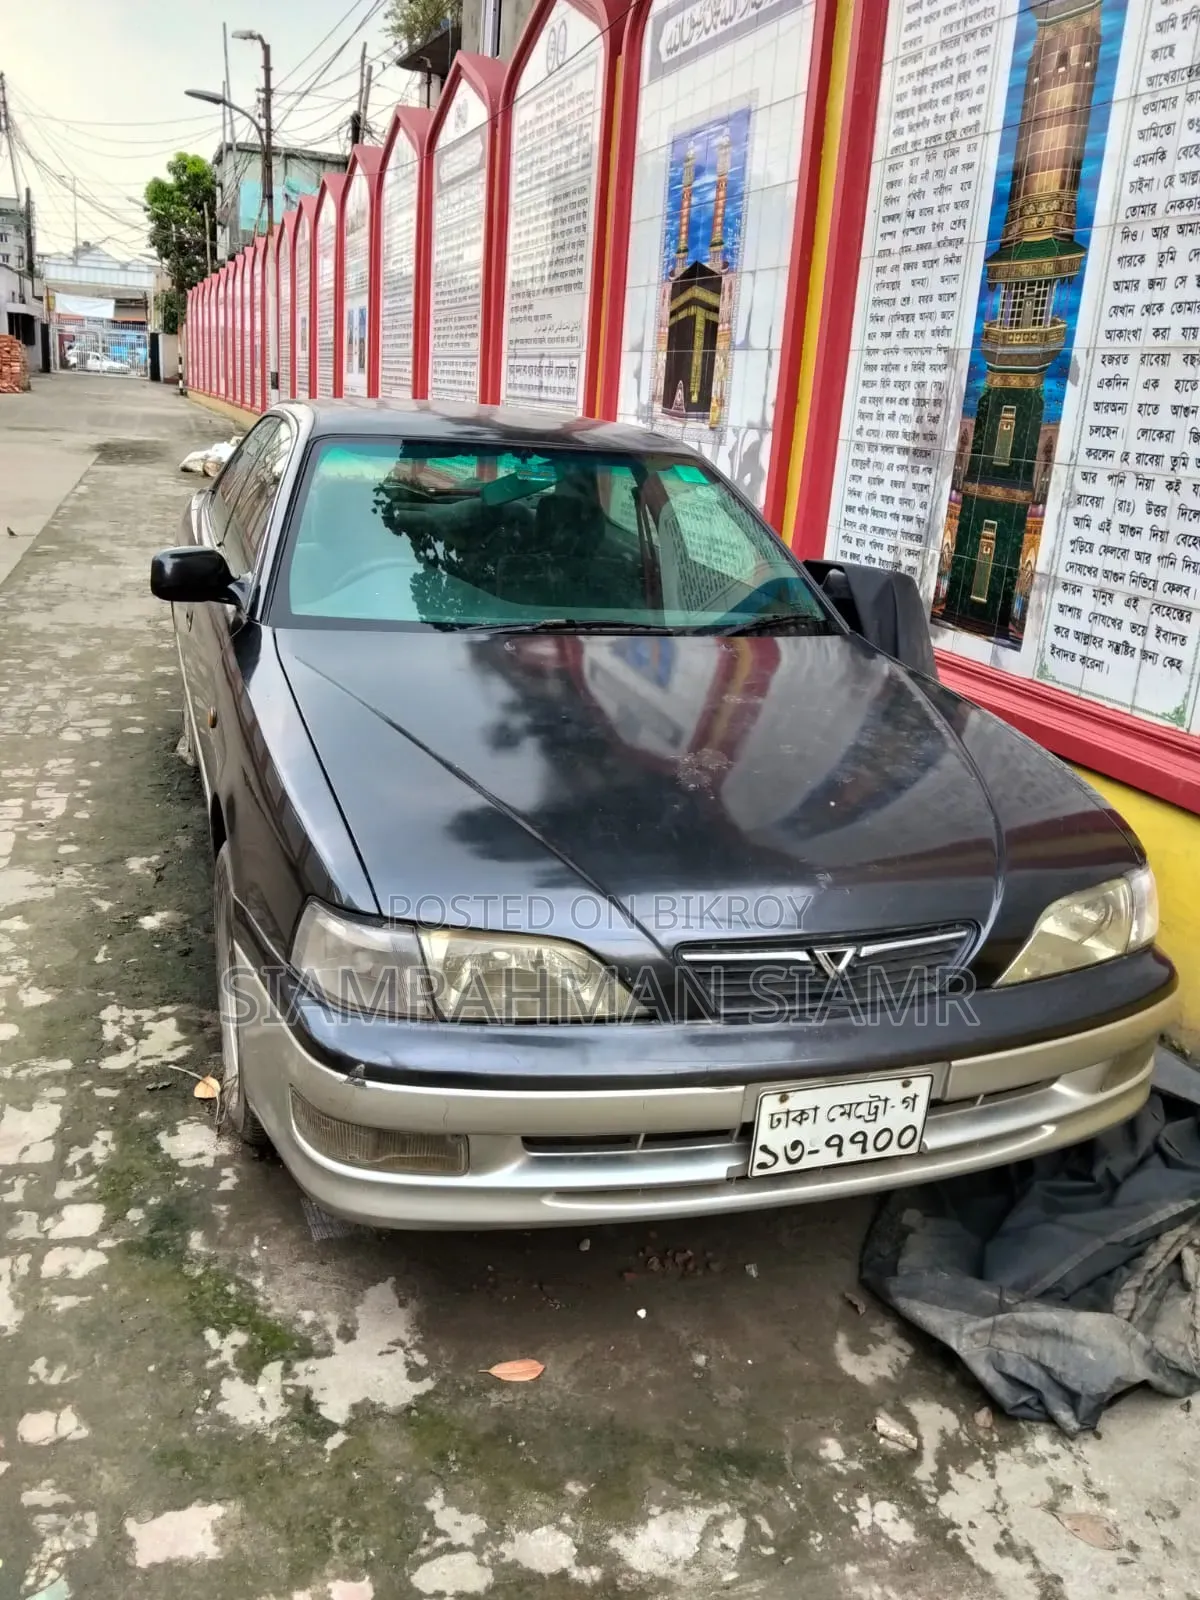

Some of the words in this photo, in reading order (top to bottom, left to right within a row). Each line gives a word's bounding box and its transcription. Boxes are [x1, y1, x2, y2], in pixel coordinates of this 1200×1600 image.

[1155, 12, 1178, 34] আমি
[1181, 4, 1200, 32] দুনি
[1151, 43, 1176, 63] কাছে
[1186, 90, 1200, 106] কা
[1137, 121, 1176, 142] আমিতো
[1133, 146, 1168, 168] এমনকি
[1178, 143, 1200, 161] বেহে
[1164, 174, 1176, 189] হে
[1179, 169, 1200, 187] আল্ল
[1125, 203, 1157, 220] তোমার
[1152, 225, 1170, 240] আর
[1117, 253, 1146, 270] গারকে
[1157, 246, 1177, 269] তুমি
[1189, 247, 1200, 263] দে
[1113, 279, 1141, 293] আমার
[1148, 276, 1168, 292] জন্য
[1174, 275, 1189, 289] সে
[1108, 304, 1136, 318] যেখান
[1140, 302, 1166, 317] থেকে
[1104, 327, 1143, 343] আকাংখা
[1152, 325, 1172, 342] করা
[1181, 325, 1200, 342] যায়
[1100, 353, 1131, 368] হজরত
[1140, 352, 1172, 367] রাবেয়া
[1096, 373, 1131, 392] একদিন
[1142, 378, 1161, 392] এক
[1174, 378, 1200, 394] হাতে
[1137, 402, 1161, 417] হাতে
[1170, 403, 1200, 420] আগুন
[1136, 427, 1176, 444] লোকেরা
[1189, 426, 1200, 446] জি
[1085, 447, 1116, 462] করলেন
[1120, 450, 1131, 467] হে
[1135, 452, 1165, 468] রাবেয়া
[1170, 451, 1190, 473] তুমি
[1080, 470, 1098, 485] আর
[1107, 471, 1127, 488] পানি
[1134, 473, 1155, 492] নিয়া
[1165, 478, 1182, 496] কই
[1076, 494, 1105, 510] রাবেয়া
[1113, 497, 1135, 517] (রাঃ)
[1145, 500, 1168, 519] উত্তর
[1177, 502, 1200, 522] দিলে
[1072, 513, 1092, 532] আমি
[1098, 517, 1112, 537] এই
[1118, 523, 1143, 539] আগুন
[1149, 523, 1170, 544] দিয়া
[1176, 532, 1200, 551] বেহে
[1098, 544, 1130, 561] ফেলবো
[1134, 550, 1152, 566] আর
[1157, 551, 1178, 571] পানি
[1065, 560, 1099, 579] দোযখের
[1102, 567, 1126, 585] আগুন
[1129, 570, 1158, 592] নিভিয়ে
[1061, 581, 1084, 597] কারন
[1092, 588, 1115, 608] মানুষ
[1124, 596, 1140, 614] এই
[1150, 602, 1193, 625] বেহেস্তের
[1057, 602, 1082, 621] আশায়
[1088, 611, 1124, 632] দোযখের
[1129, 620, 1148, 638] ভয়ে
[1154, 624, 1188, 648] ইবাদত
[1050, 643, 1076, 664] ইবাদত
[1053, 624, 1070, 640] করে
[1073, 629, 1105, 650] আল্লাহর
[1140, 647, 1159, 666] জন্য
[1163, 655, 1184, 676] কেহ
[769, 1106, 820, 1130] ঢাকা
[756, 1124, 918, 1170] ১৩-৭৭০০
